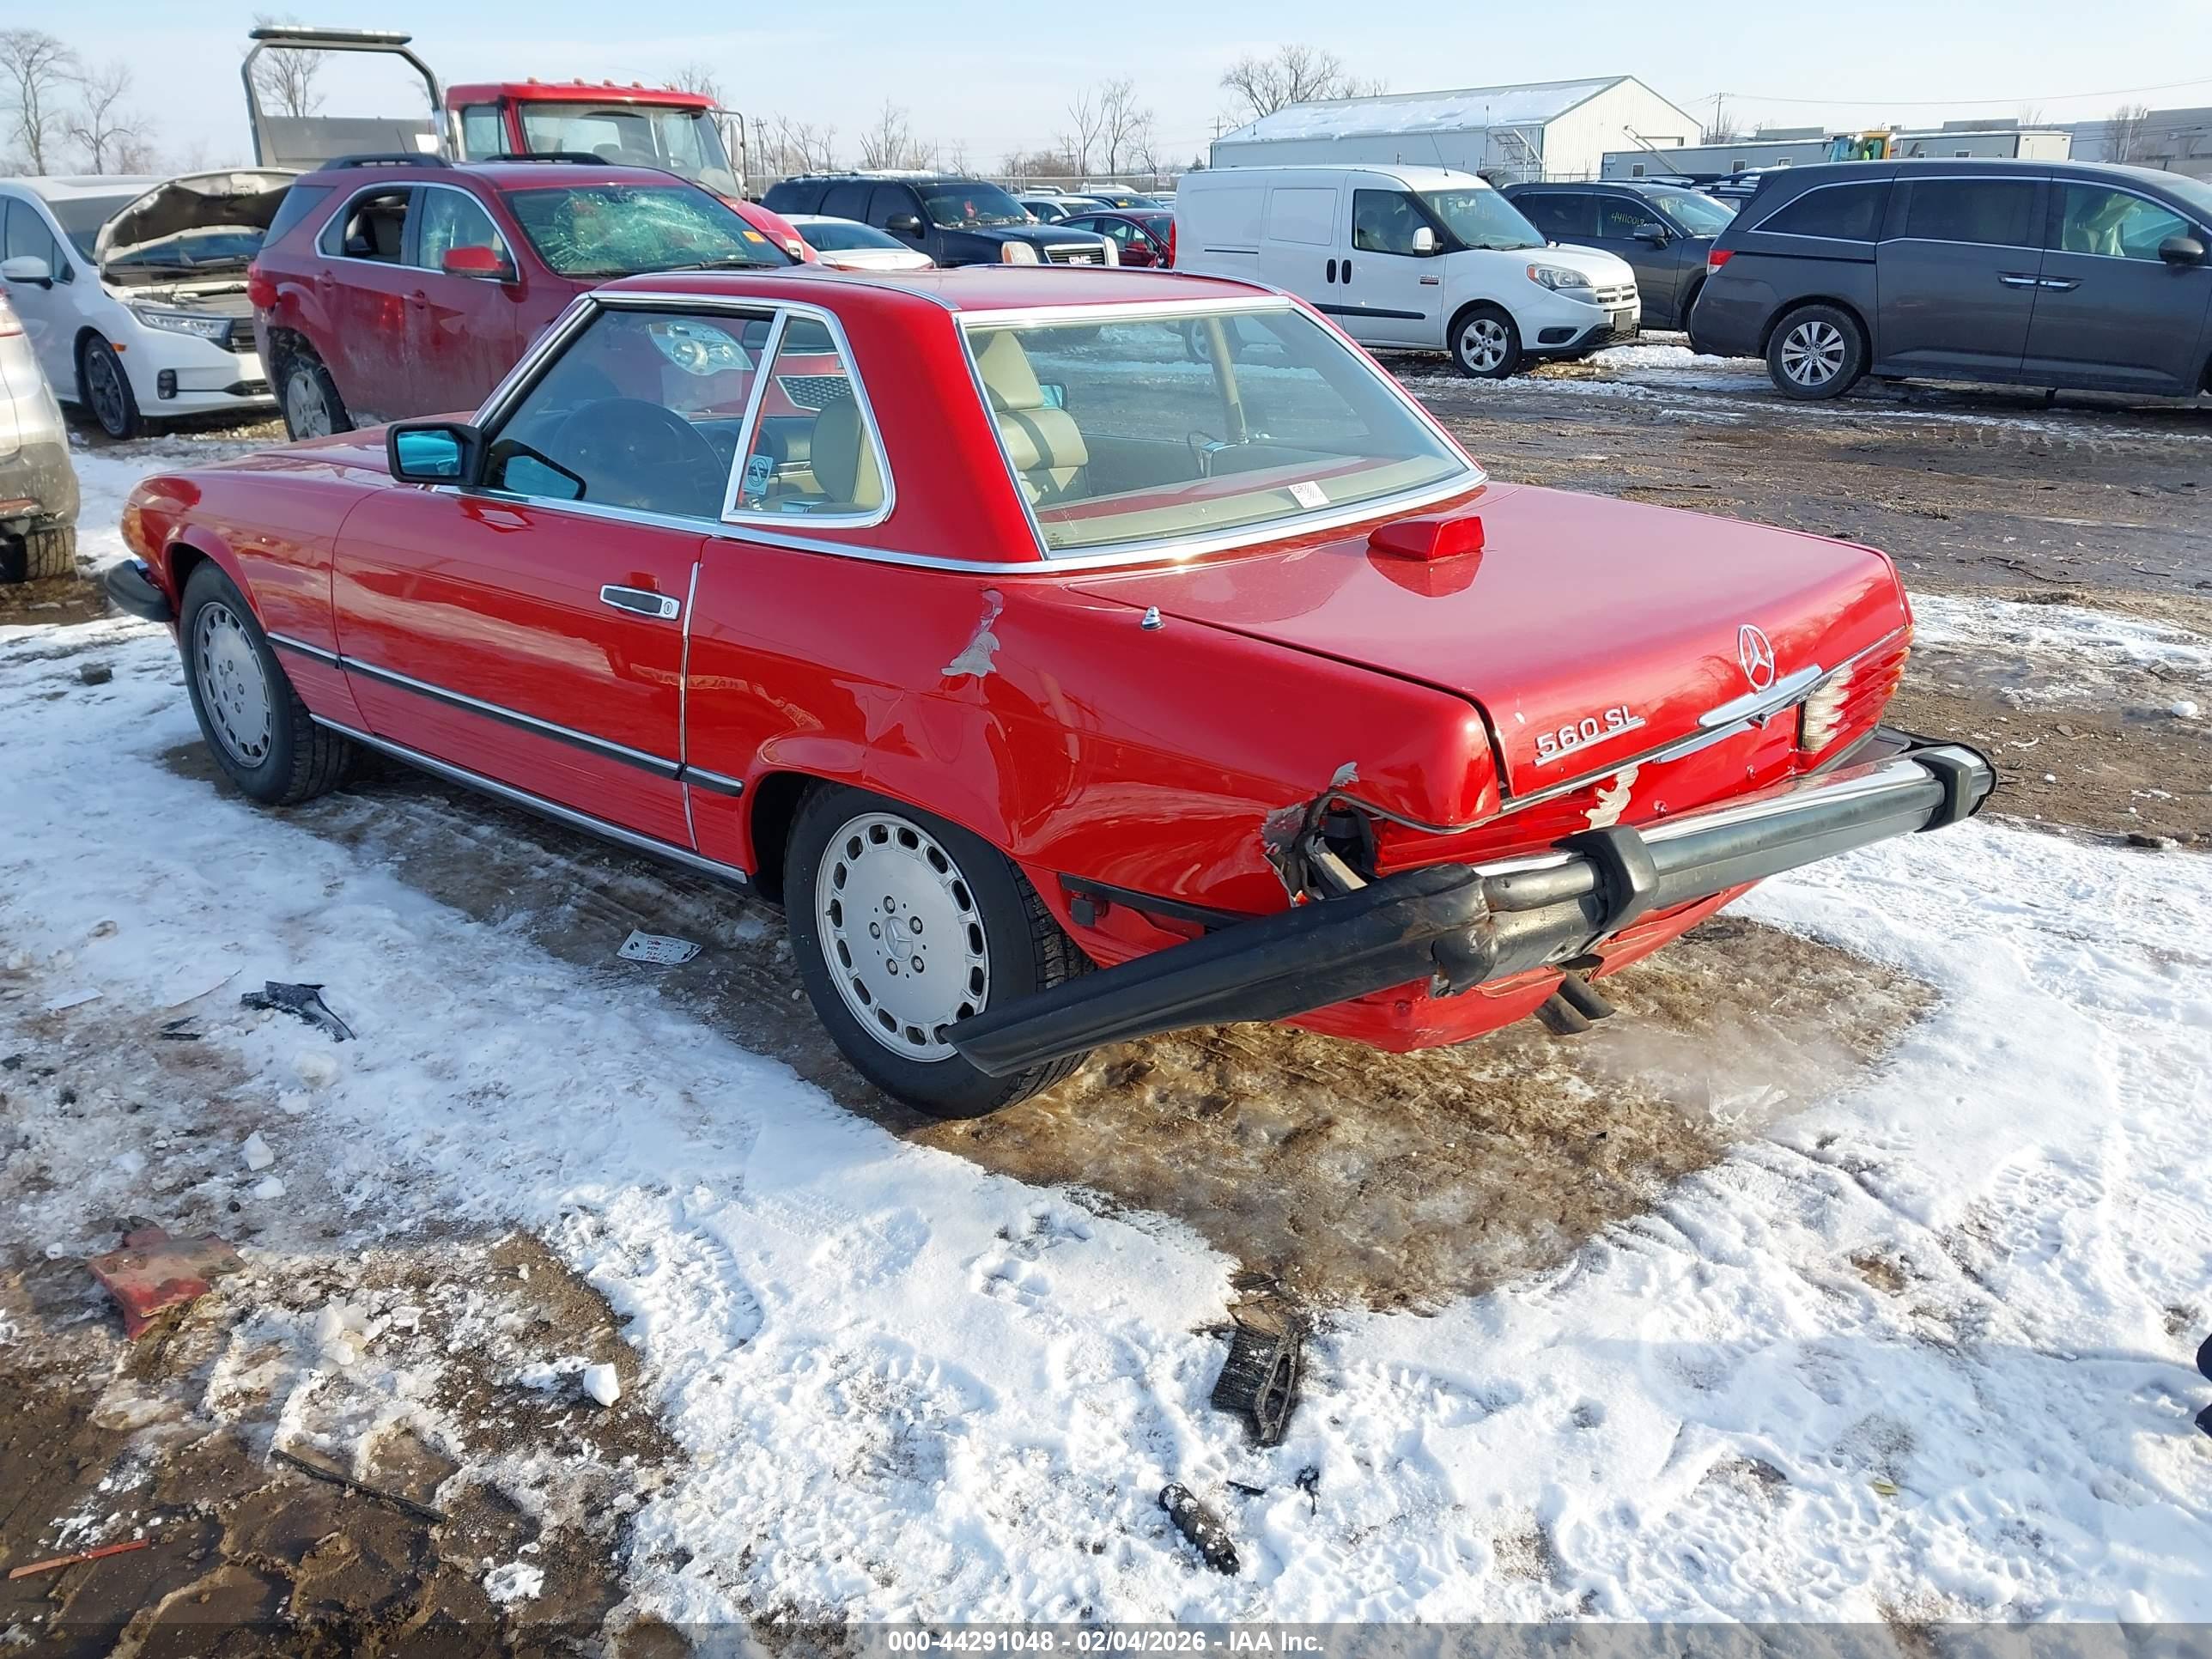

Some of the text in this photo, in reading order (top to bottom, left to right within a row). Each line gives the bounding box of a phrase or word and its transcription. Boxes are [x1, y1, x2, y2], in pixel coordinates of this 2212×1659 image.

[1068, 255, 1092, 265] GMC
[1534, 704, 1640, 757] 560 SL
